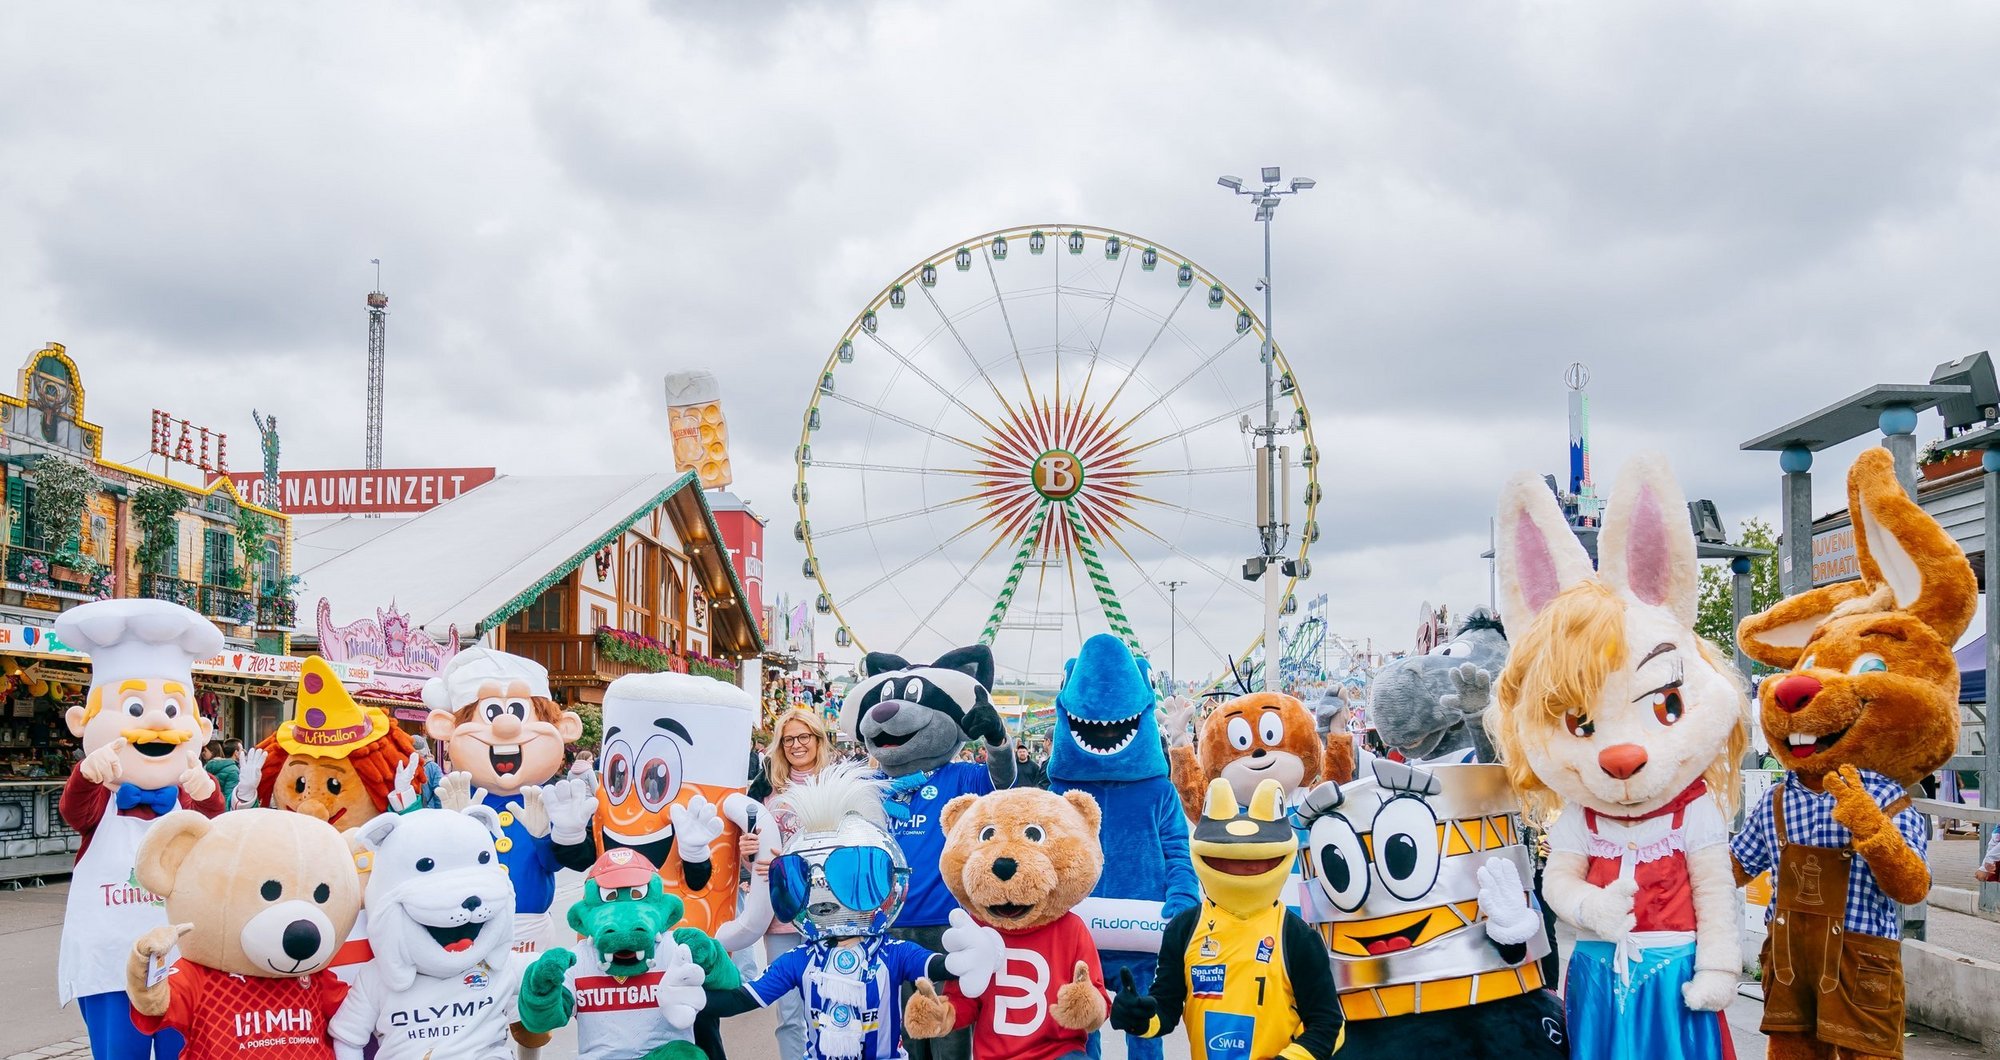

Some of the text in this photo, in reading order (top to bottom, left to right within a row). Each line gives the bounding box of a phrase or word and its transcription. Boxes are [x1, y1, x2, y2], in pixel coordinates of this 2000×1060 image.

[1039, 456, 1075, 491] B
[236, 475, 464, 507] #GNAUMEINZELT
[247, 655, 277, 674] Herz
[304, 729, 357, 745] luftballon
[1191, 966, 1225, 976] Sparda
[1199, 974, 1224, 983] Bank
[576, 983, 658, 1007] STUTTGAR
[1254, 976, 1266, 1006] 1
[265, 1008, 312, 1033] MHP
[239, 1036, 319, 1050] A PORSCHE COMPANY
[1218, 1037, 1246, 1049] SWLB
